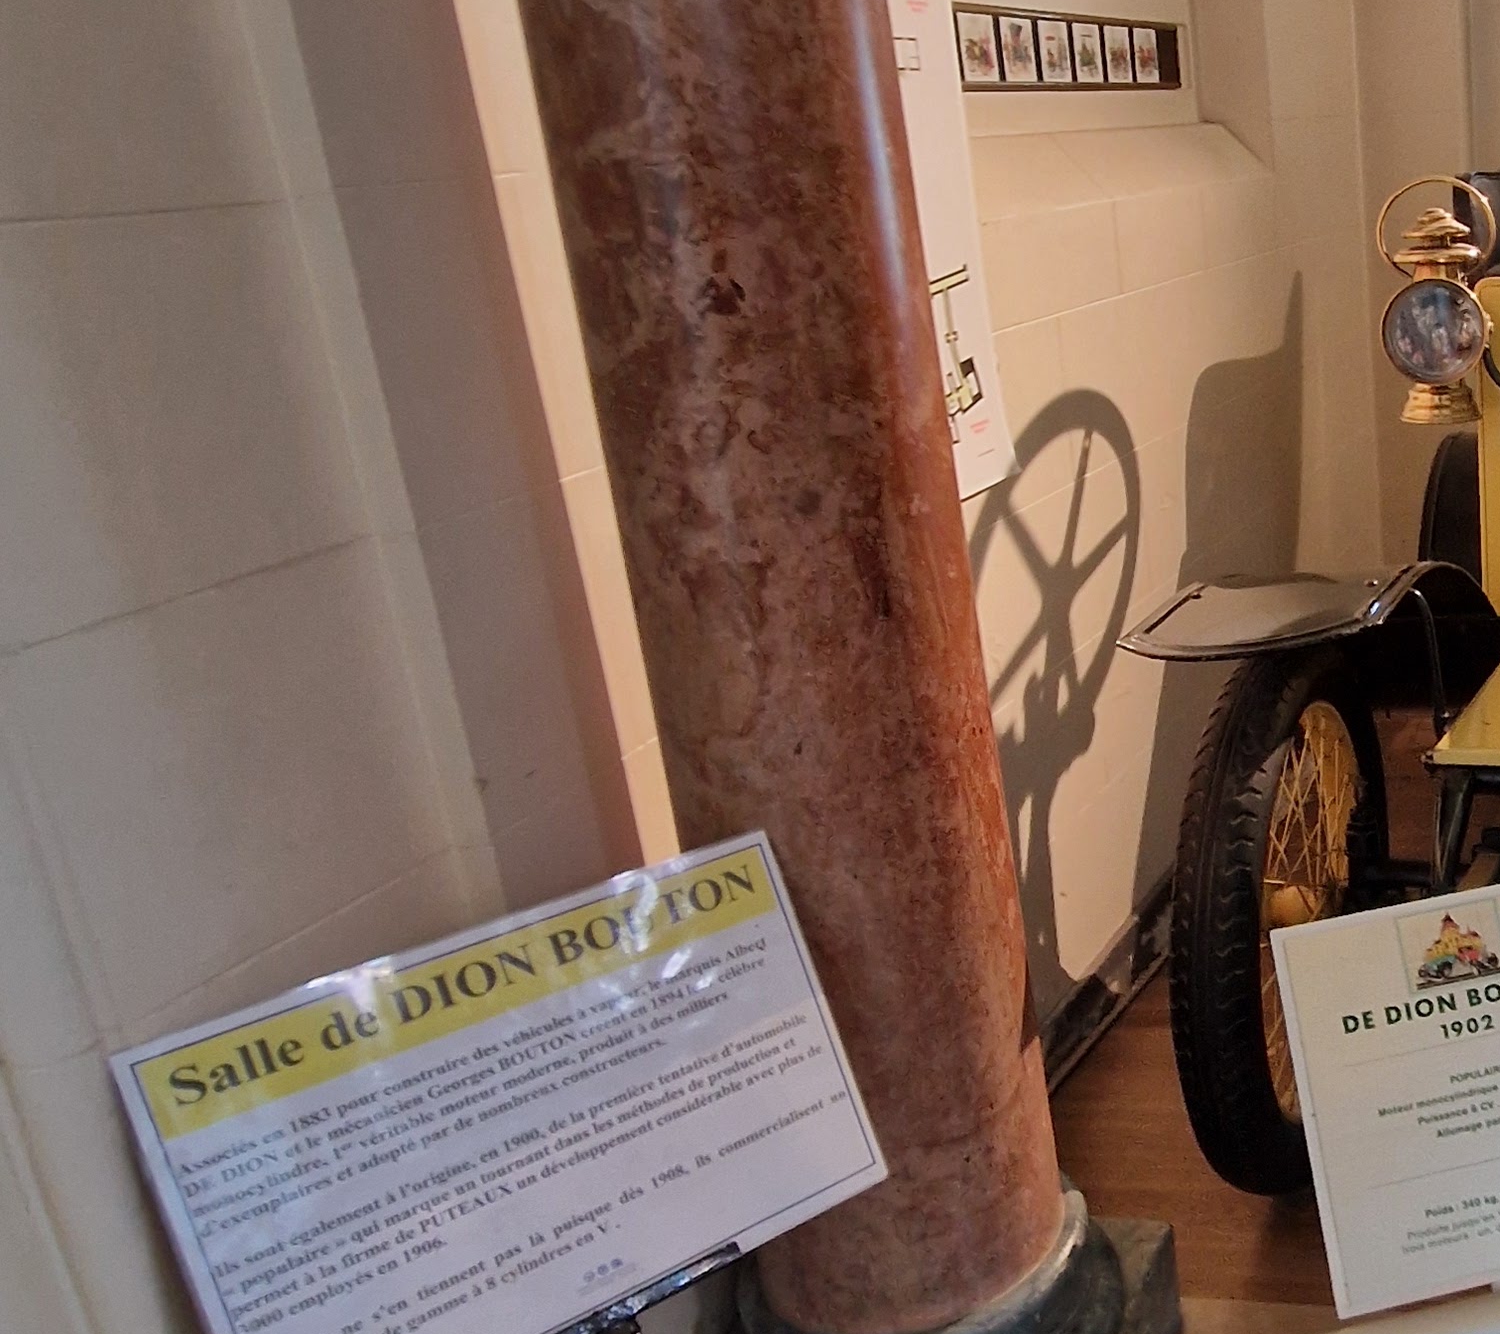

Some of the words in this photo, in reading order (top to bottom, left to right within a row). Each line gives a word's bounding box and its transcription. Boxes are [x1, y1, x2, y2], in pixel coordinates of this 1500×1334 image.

[168, 1037, 306, 1106] Salle
[316, 1011, 380, 1051] de
[390, 945, 536, 1024] DION
[176, 1140, 258, 1178] Associés
[261, 1129, 286, 1145] en
[288, 1107, 332, 1133] 1883
[336, 1093, 380, 1118] pour
[382, 1057, 469, 1097] construire
[470, 1045, 500, 1062] des
[503, 1016, 574, 1049] véhicules
[576, 1008, 585, 1020] à
[647, 981, 660, 992] le
[183, 1176, 217, 1198] DE
[220, 1151, 279, 1183] DION
[284, 1141, 303, 1158] et
[304, 1136, 322, 1149] le
[326, 1096, 425, 1141] mécanicien
[426, 1068, 496, 1100] Georges
[497, 1031, 578, 1072] BOUTON
[631, 1007, 648, 1018] en
[651, 989, 684, 1010] 1894
[718, 960, 765, 983] célèbre
[359, 1113, 436, 1150] véritable
[439, 1087, 499, 1117] moteur
[502, 1060, 577, 1091] moderne,
[579, 1029, 635, 1063] produit
[638, 1023, 648, 1035] à
[649, 1016, 674, 1030] des
[677, 993, 729, 1019] milliers
[1341, 1010, 1376, 1034] DE
[1384, 992, 1458, 1025] DION
[1439, 1013, 1495, 1040] 1902
[214, 1262, 241, 1279] Ils
[243, 1240, 285, 1267] sont
[287, 1198, 381, 1247] également
[384, 1192, 395, 1205] à
[479, 1150, 499, 1163] en
[503, 1130, 546, 1153] 1900,
[546, 1120, 568, 1134] de
[569, 1112, 586, 1124] la
[588, 1082, 656, 1119] première
[657, 1054, 720, 1086] tentative
[720, 1016, 807, 1058] d'automobile
[239, 1246, 331, 1296] populaire
[351, 1221, 380, 1246] qui
[384, 1193, 451, 1228] marque
[455, 1182, 477, 1196] un
[479, 1146, 551, 1185] tournant
[553, 1131, 590, 1152] dans
[592, 1121, 614, 1135] les
[616, 1089, 685, 1124] méthodes
[686, 1080, 705, 1092] de
[708, 1047, 781, 1087] production
[783, 1037, 796, 1050] et
[336, 1165, 354, 1182] et
[357, 1139, 417, 1173] adopté
[421, 1129, 450, 1149] par
[451, 1119, 474, 1133] de
[478, 1084, 559, 1122] nombreux
[561, 1042, 666, 1087] constructeurs.
[1378, 1104, 1413, 1117] Moteur
[1416, 1085, 1498, 1108] monocylindrique
[1417, 1109, 1468, 1125] Puissance
[1435, 1123, 1483, 1138] Allumage
[231, 1280, 300, 1324] permet
[302, 1272, 316, 1287] à
[319, 1266, 338, 1279] la
[340, 1242, 392, 1270] firme
[393, 1231, 416, 1246] de
[418, 1184, 512, 1234] PUTEAUX
[517, 1176, 538, 1190] un
[539, 1120, 654, 1180] développement
[656, 1083, 744, 1127] considérable
[746, 1068, 776, 1086] avec
[778, 1055, 805, 1074] plus
[806, 1047, 822, 1058] de
[370, 1299, 409, 1323] s'en
[415, 1259, 486, 1301] tiennent
[493, 1245, 522, 1267] pas
[528, 1230, 545, 1247] là
[552, 1202, 613, 1239] puisque
[616, 1187, 644, 1205] dès
[694, 1154, 712, 1168] ils
[718, 1098, 824, 1157] commercialisent
[829, 1091, 846, 1103] un
[1424, 1205, 1454, 1219] Poids
[288, 1272, 374, 1317] employés
[377, 1261, 399, 1276] en
[403, 1239, 448, 1263] 1906.
[405, 1294, 469, 1334] gamme
[470, 1284, 483, 1298] à
[484, 1277, 497, 1291] 8
[500, 1244, 573, 1284] cylindres
[575, 1233, 594, 1247] en
[596, 1221, 611, 1236] V
